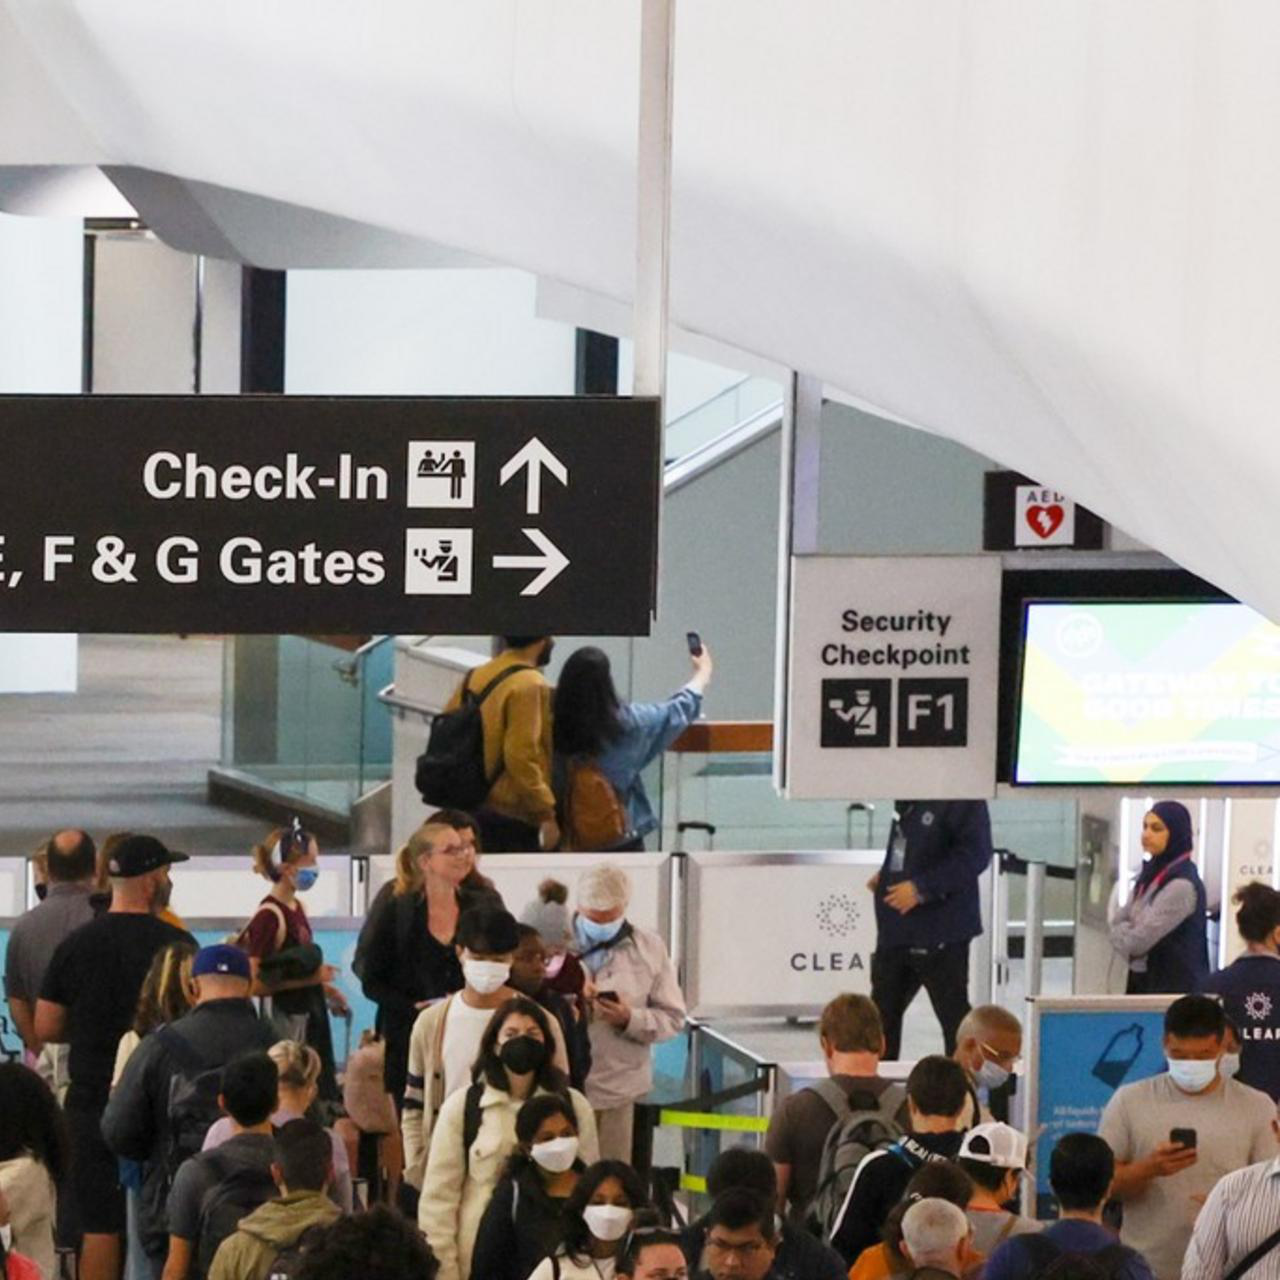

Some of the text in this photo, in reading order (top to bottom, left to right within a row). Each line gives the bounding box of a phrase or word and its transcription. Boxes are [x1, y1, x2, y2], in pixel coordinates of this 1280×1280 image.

[144, 452, 388, 500] Check-In
[43, 536, 75, 582] F
[91, 536, 138, 583] &
[157, 536, 199, 584] G
[219, 536, 385, 585] Gates
[842, 609, 952, 637] Security
[821, 642, 971, 670] Checkpoint
[907, 694, 954, 731] F1
[1239, 864, 1274, 874] CLEA
[790, 952, 865, 972] CLEA
[1243, 1027, 1280, 1040] LEA
